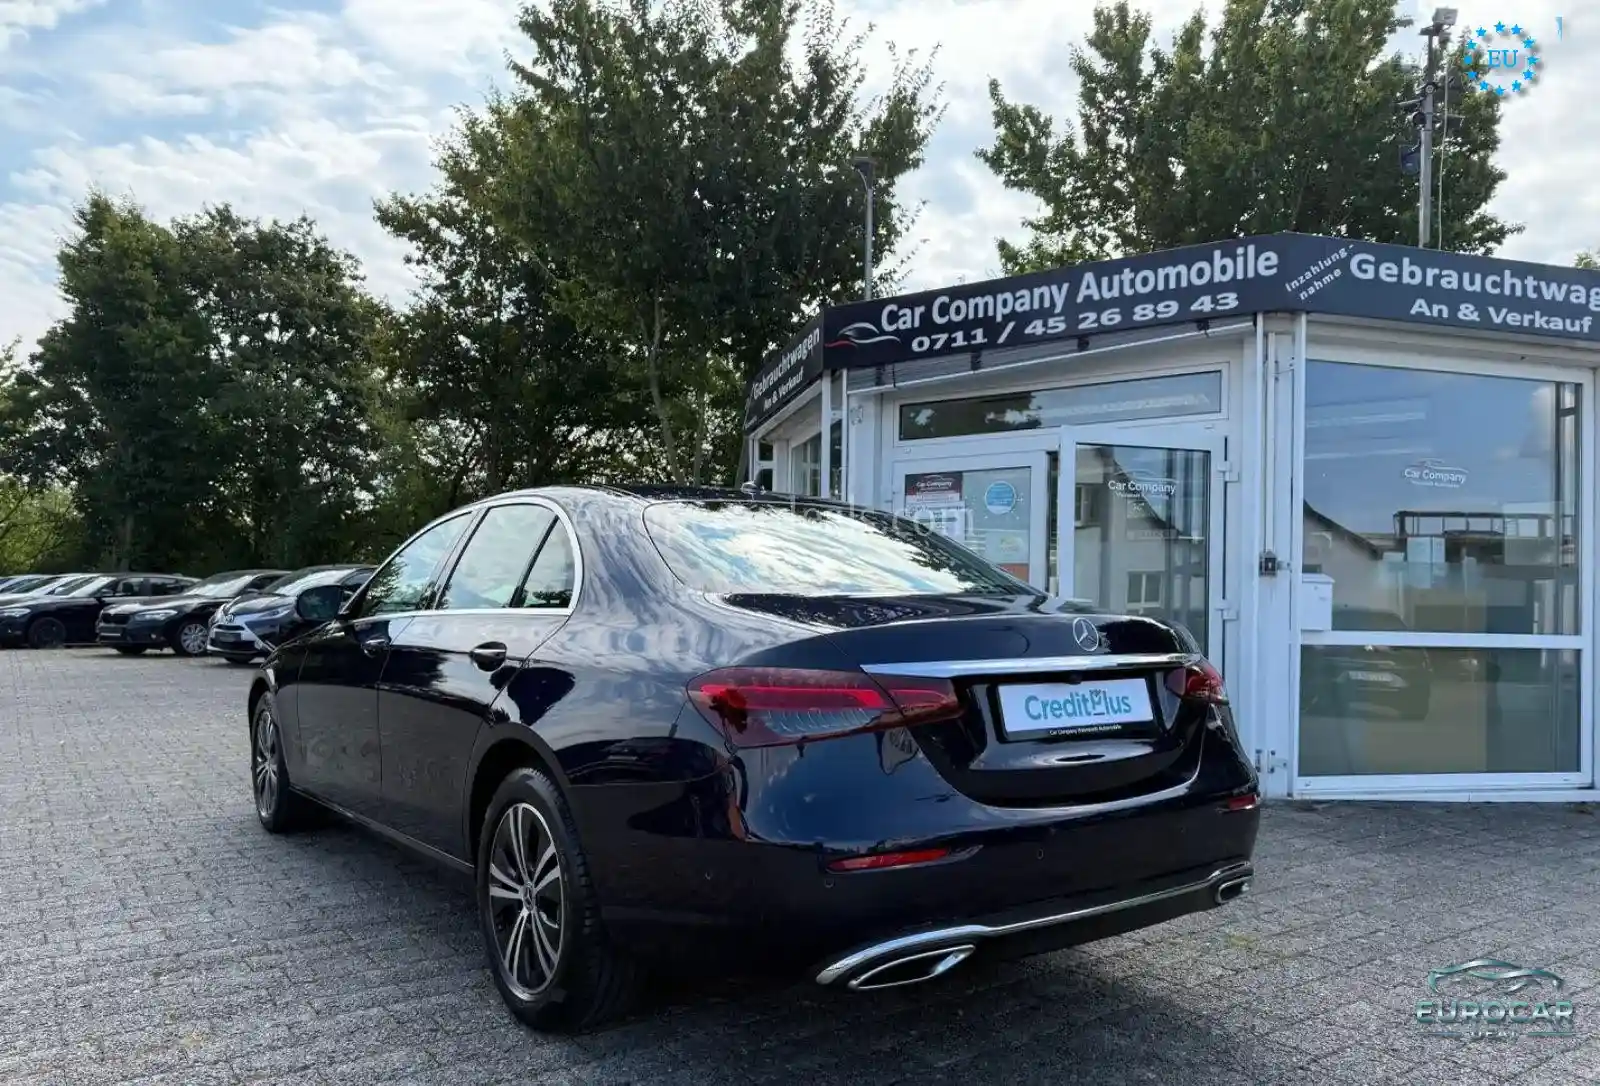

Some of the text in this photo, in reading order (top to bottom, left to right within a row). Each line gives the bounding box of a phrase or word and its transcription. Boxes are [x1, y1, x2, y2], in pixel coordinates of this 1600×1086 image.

[881, 244, 1279, 333] Car Company Automobile
[1298, 267, 1342, 301] nahme
[911, 291, 1239, 353] 0711 / 45 26 89 43
[1410, 298, 1592, 334] An & Verkauf
[752, 327, 820, 400] Gebrauchtwagen
[779, 366, 804, 399] Verkauf
[1108, 480, 1177, 495] Car Company
[1404, 469, 1467, 484] Car Company
[1025, 689, 1132, 720] CreditPlus
